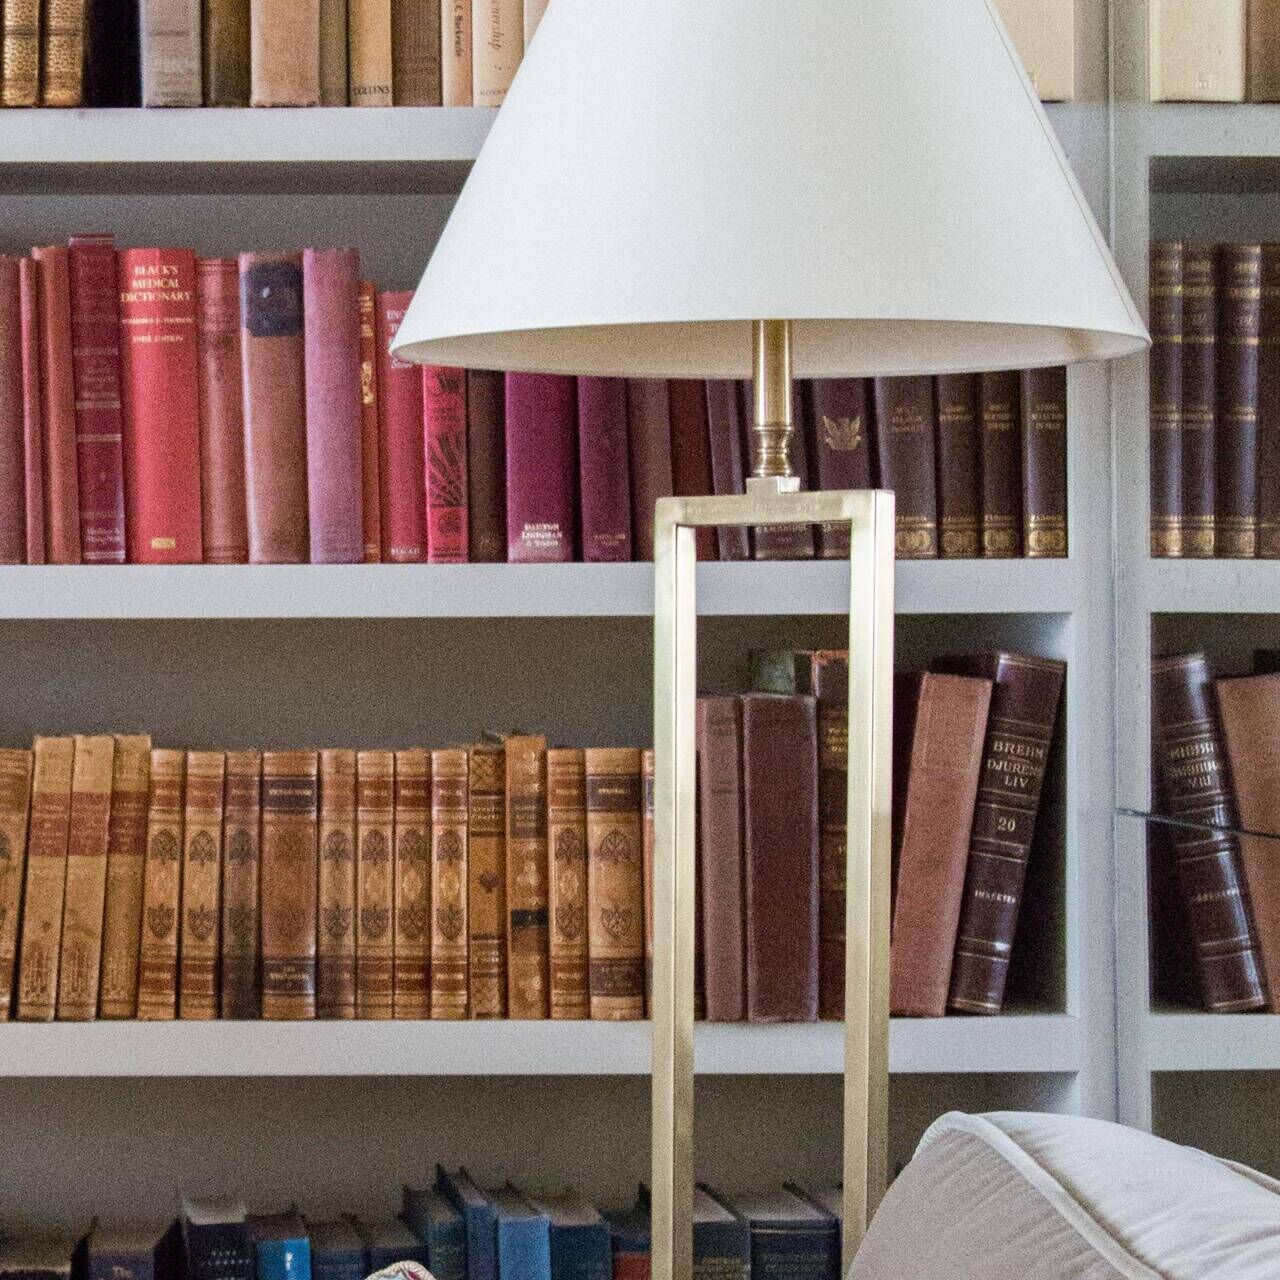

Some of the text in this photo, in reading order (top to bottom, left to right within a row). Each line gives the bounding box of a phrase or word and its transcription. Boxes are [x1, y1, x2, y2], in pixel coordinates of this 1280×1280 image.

[134, 264, 179, 276] BLACK'S
[132, 278, 180, 289] MEDICAL
[120, 291, 193, 303] DICTIONARY
[993, 740, 1044, 759] BREHM
[1004, 775, 1028, 788] LIV
[997, 817, 1017, 832] 20
